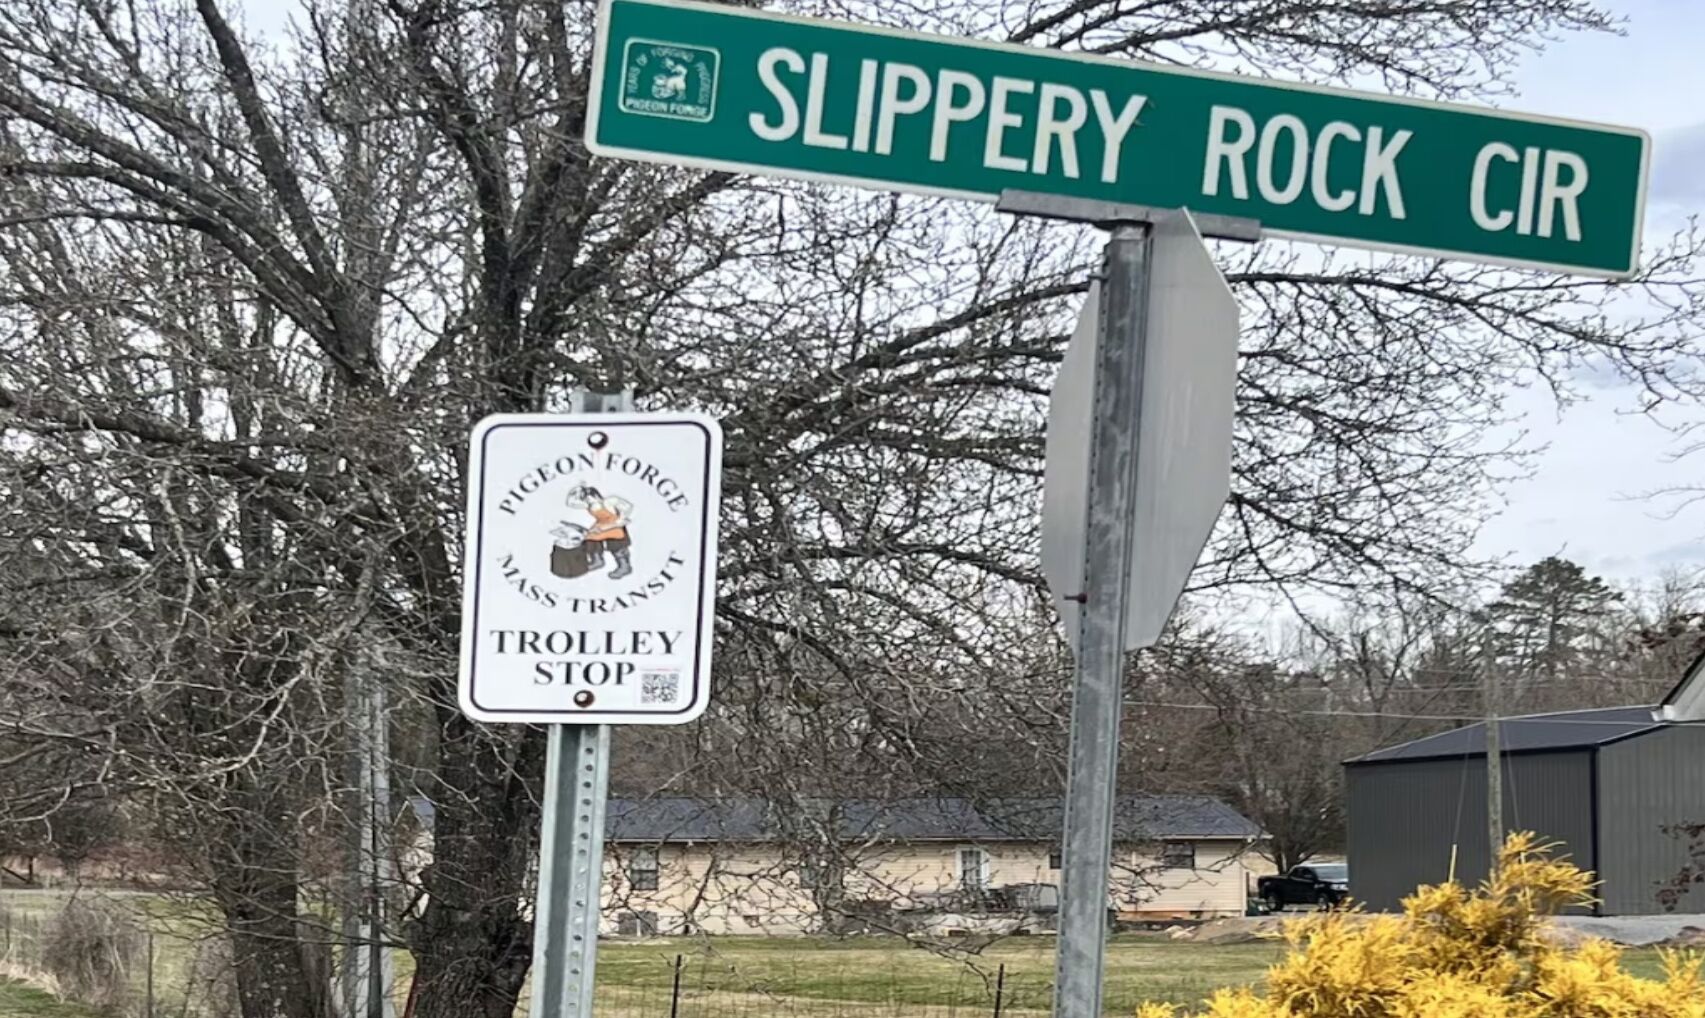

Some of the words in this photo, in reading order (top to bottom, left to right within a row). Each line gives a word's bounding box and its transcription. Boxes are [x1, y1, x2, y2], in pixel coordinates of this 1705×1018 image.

[625, 97, 668, 113] PIGEON
[669, 102, 707, 117] FORGE
[748, 47, 1148, 184] SLIPPERY
[1202, 105, 1414, 219] ROCK
[1469, 142, 1589, 242] CIR
[498, 452, 595, 516] PIGEON
[604, 452, 689, 513] FORGE
[496, 551, 559, 609] MASS
[567, 550, 686, 614] TRANSIT
[490, 630, 684, 656] TROLLEY
[534, 660, 636, 686] STOP
